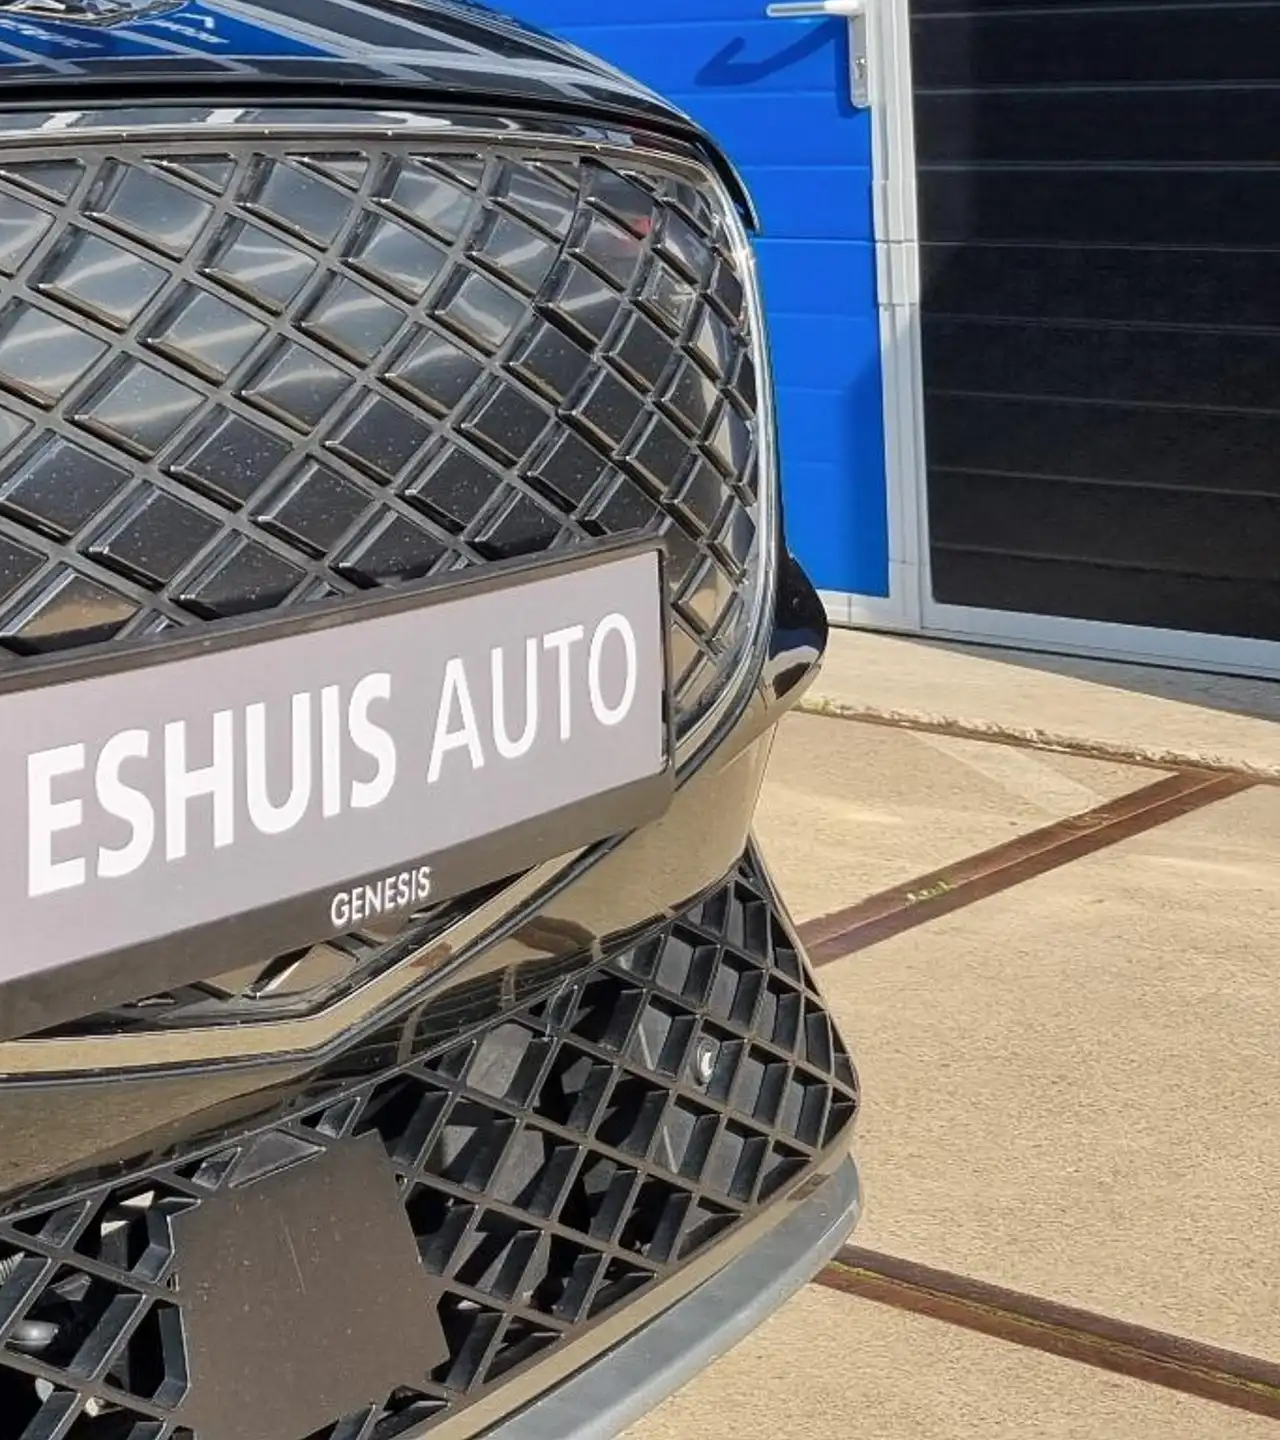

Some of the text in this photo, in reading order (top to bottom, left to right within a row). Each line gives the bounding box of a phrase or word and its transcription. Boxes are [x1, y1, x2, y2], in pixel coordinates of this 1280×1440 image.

[26, 613, 638, 899] ESHUIS AUTO
[330, 865, 432, 928] GENESIS
